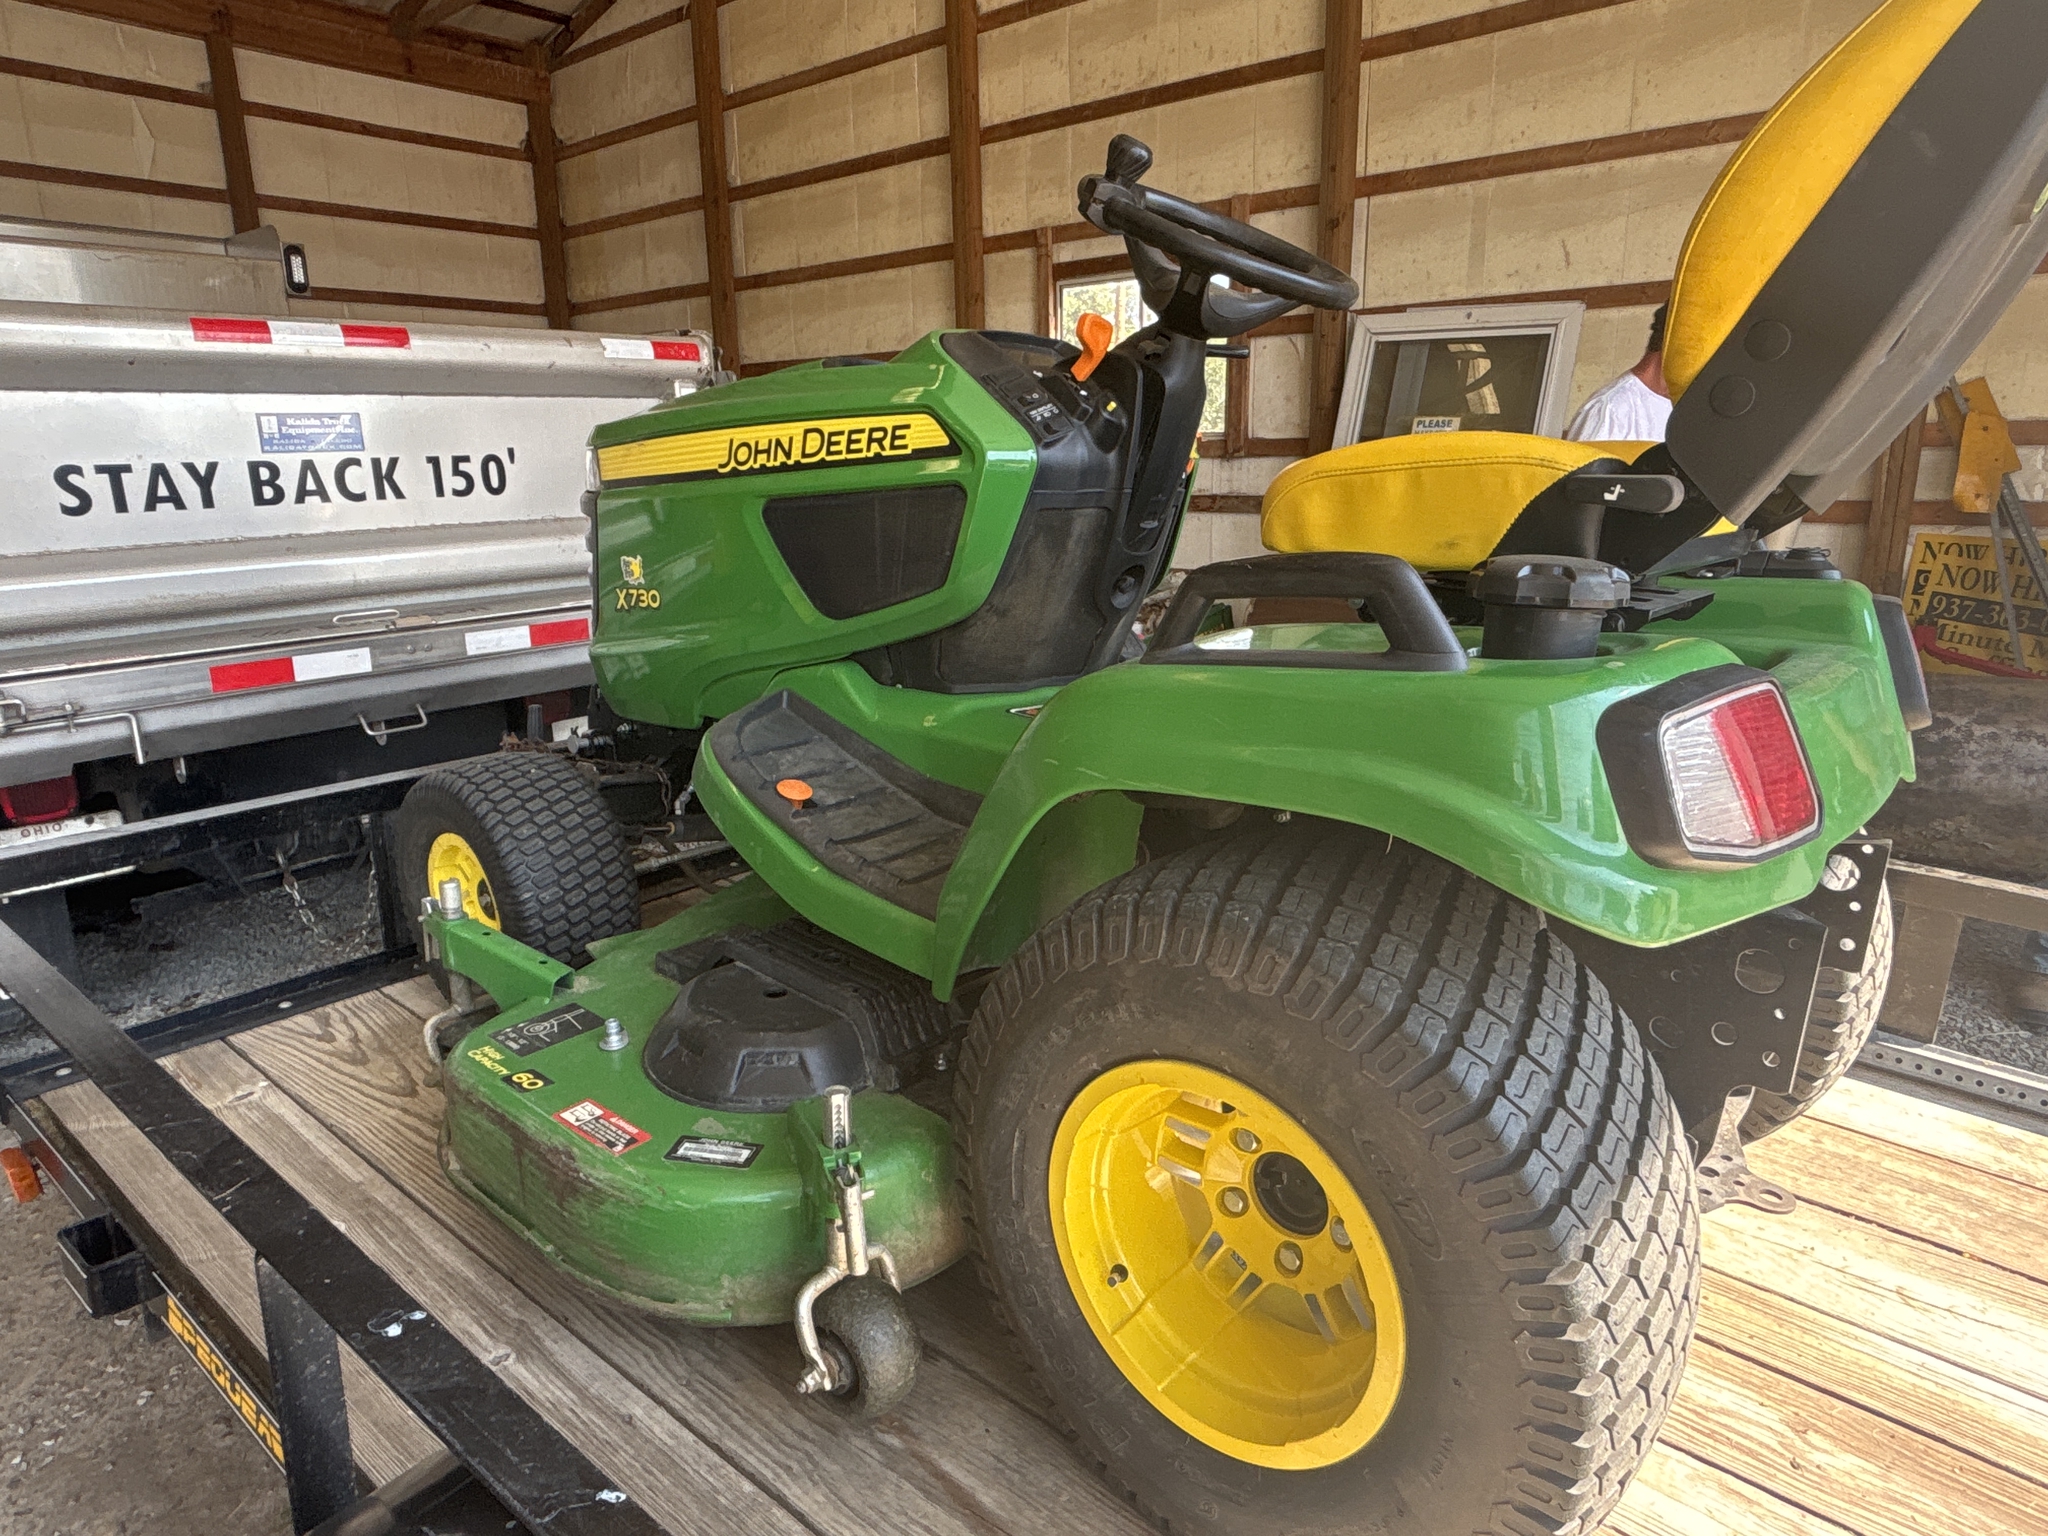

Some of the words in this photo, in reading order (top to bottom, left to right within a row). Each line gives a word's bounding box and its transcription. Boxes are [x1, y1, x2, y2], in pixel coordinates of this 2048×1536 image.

[1416, 419, 1453, 428] PLEASE
[718, 436, 794, 469] JOHN
[800, 424, 912, 460] DEERE
[53, 460, 219, 516] STAY
[246, 456, 407, 507] BACK
[425, 447, 516, 498] 150'
[1935, 563, 2000, 595] NOW
[615, 588, 661, 610] X730
[20, 822, 62, 838] OHIO
[467, 1049, 511, 1076] CAPACITY
[511, 1072, 544, 1090] 60
